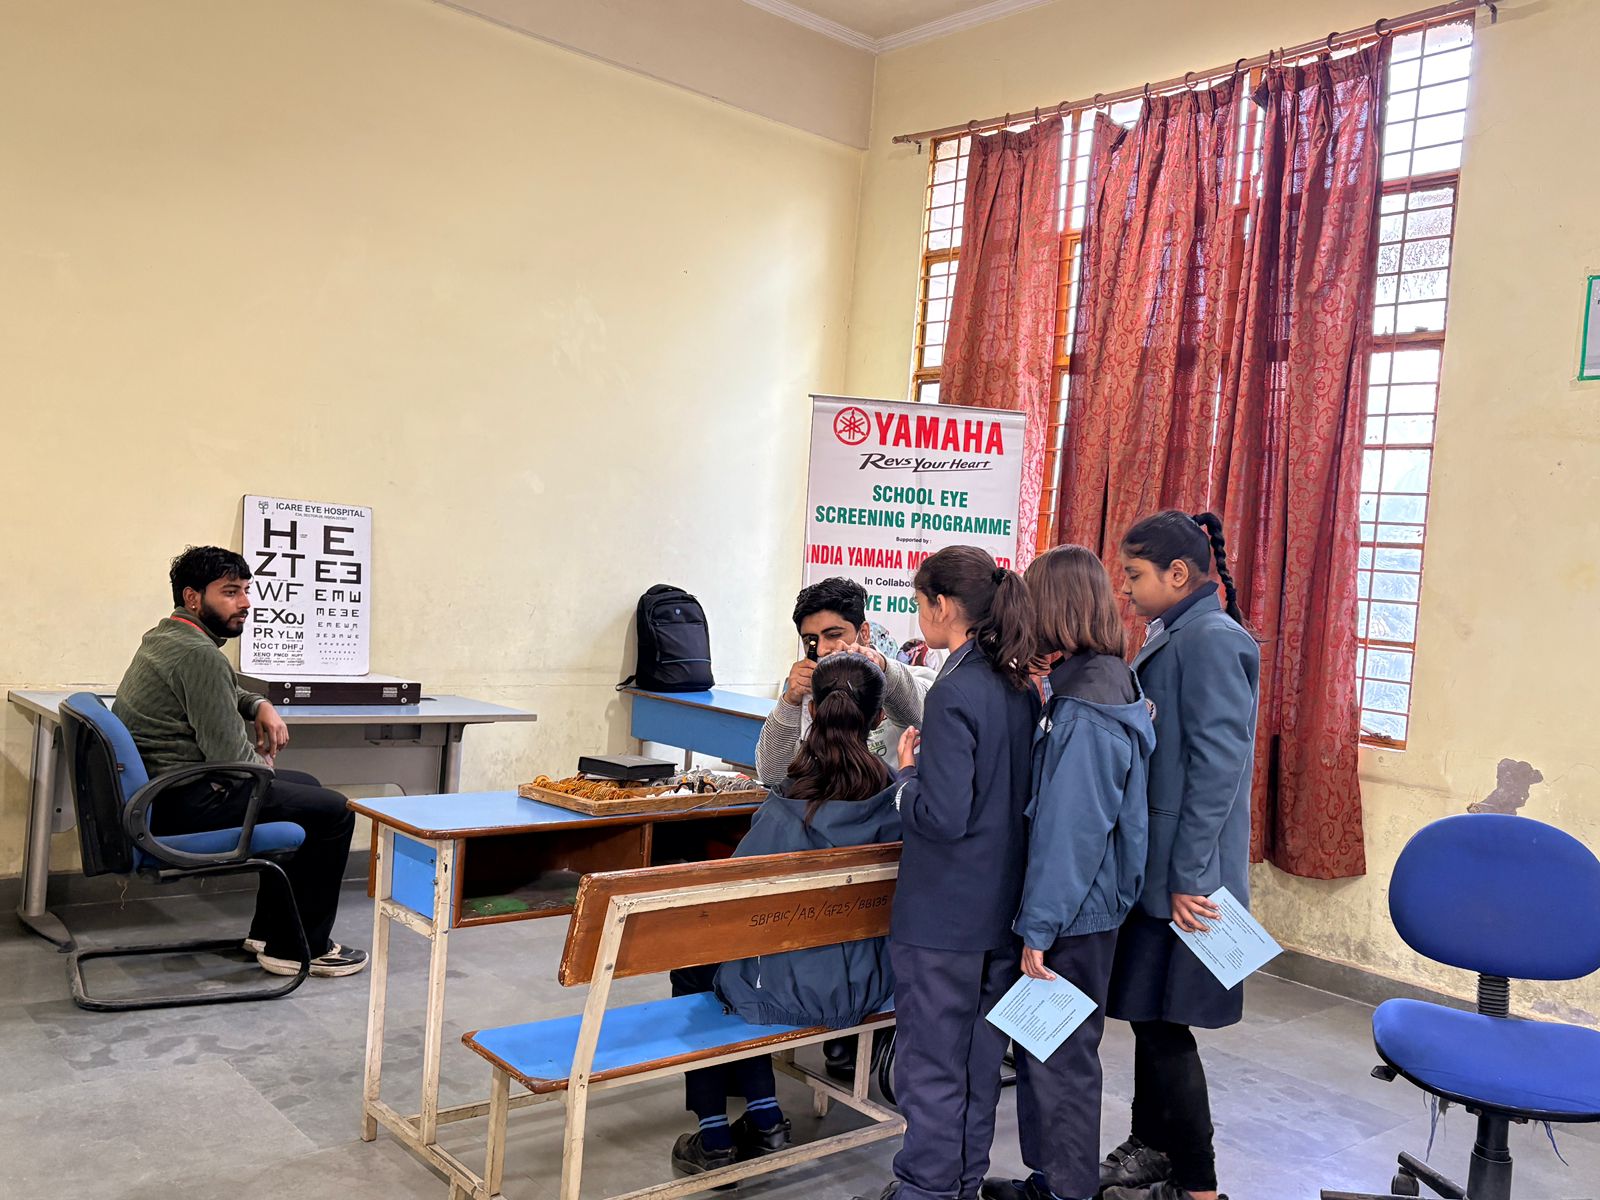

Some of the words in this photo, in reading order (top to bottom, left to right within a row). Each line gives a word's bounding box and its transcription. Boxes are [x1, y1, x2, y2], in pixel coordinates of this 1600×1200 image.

[875, 411, 1004, 455] YAMAHA
[949, 458, 992, 470] Heart
[872, 485, 935, 506] SCHOOL
[941, 490, 968, 508] EYE
[276, 502, 303, 512] ICARE
[305, 505, 322, 514] EYE
[324, 507, 365, 518] HOSPITAL
[815, 505, 905, 528] SCREENING
[911, 512, 1011, 536] PROGRAMME
[264, 518, 297, 550] H
[323, 525, 354, 556] E
[847, 546, 902, 569] YAMAHA
[907, 550, 936, 570] MO
[995, 556, 1010, 570] TD
[864, 577, 873, 586] In
[865, 594, 882, 612] YE
[887, 596, 920, 613] HOS
